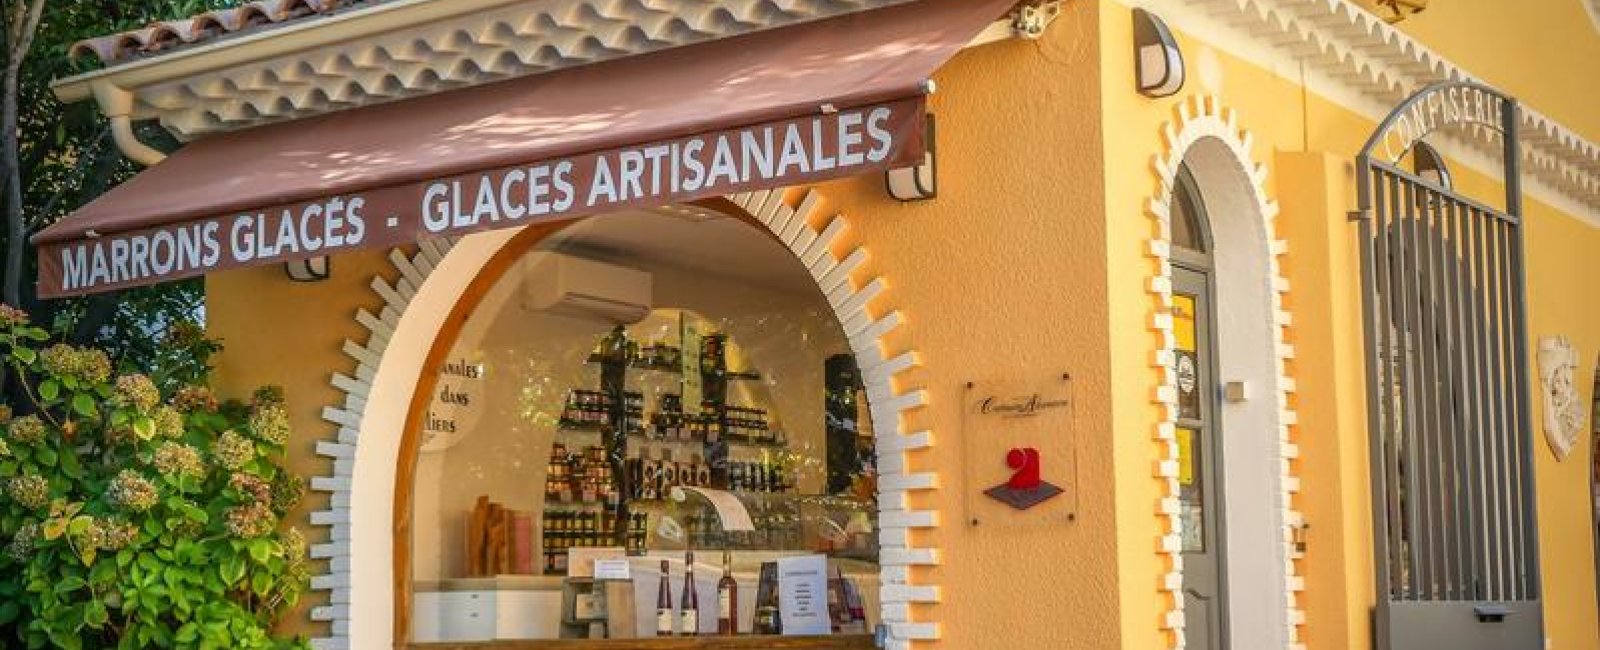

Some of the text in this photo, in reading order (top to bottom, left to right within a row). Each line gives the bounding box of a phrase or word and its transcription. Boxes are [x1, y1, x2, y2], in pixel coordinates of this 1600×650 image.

[1384, 88, 1503, 162] CONFISERIE
[62, 223, 219, 290] MARRONS
[230, 198, 365, 262] GLACÉS
[422, 166, 575, 232] GLACES
[588, 108, 892, 206] ARTISANALES
